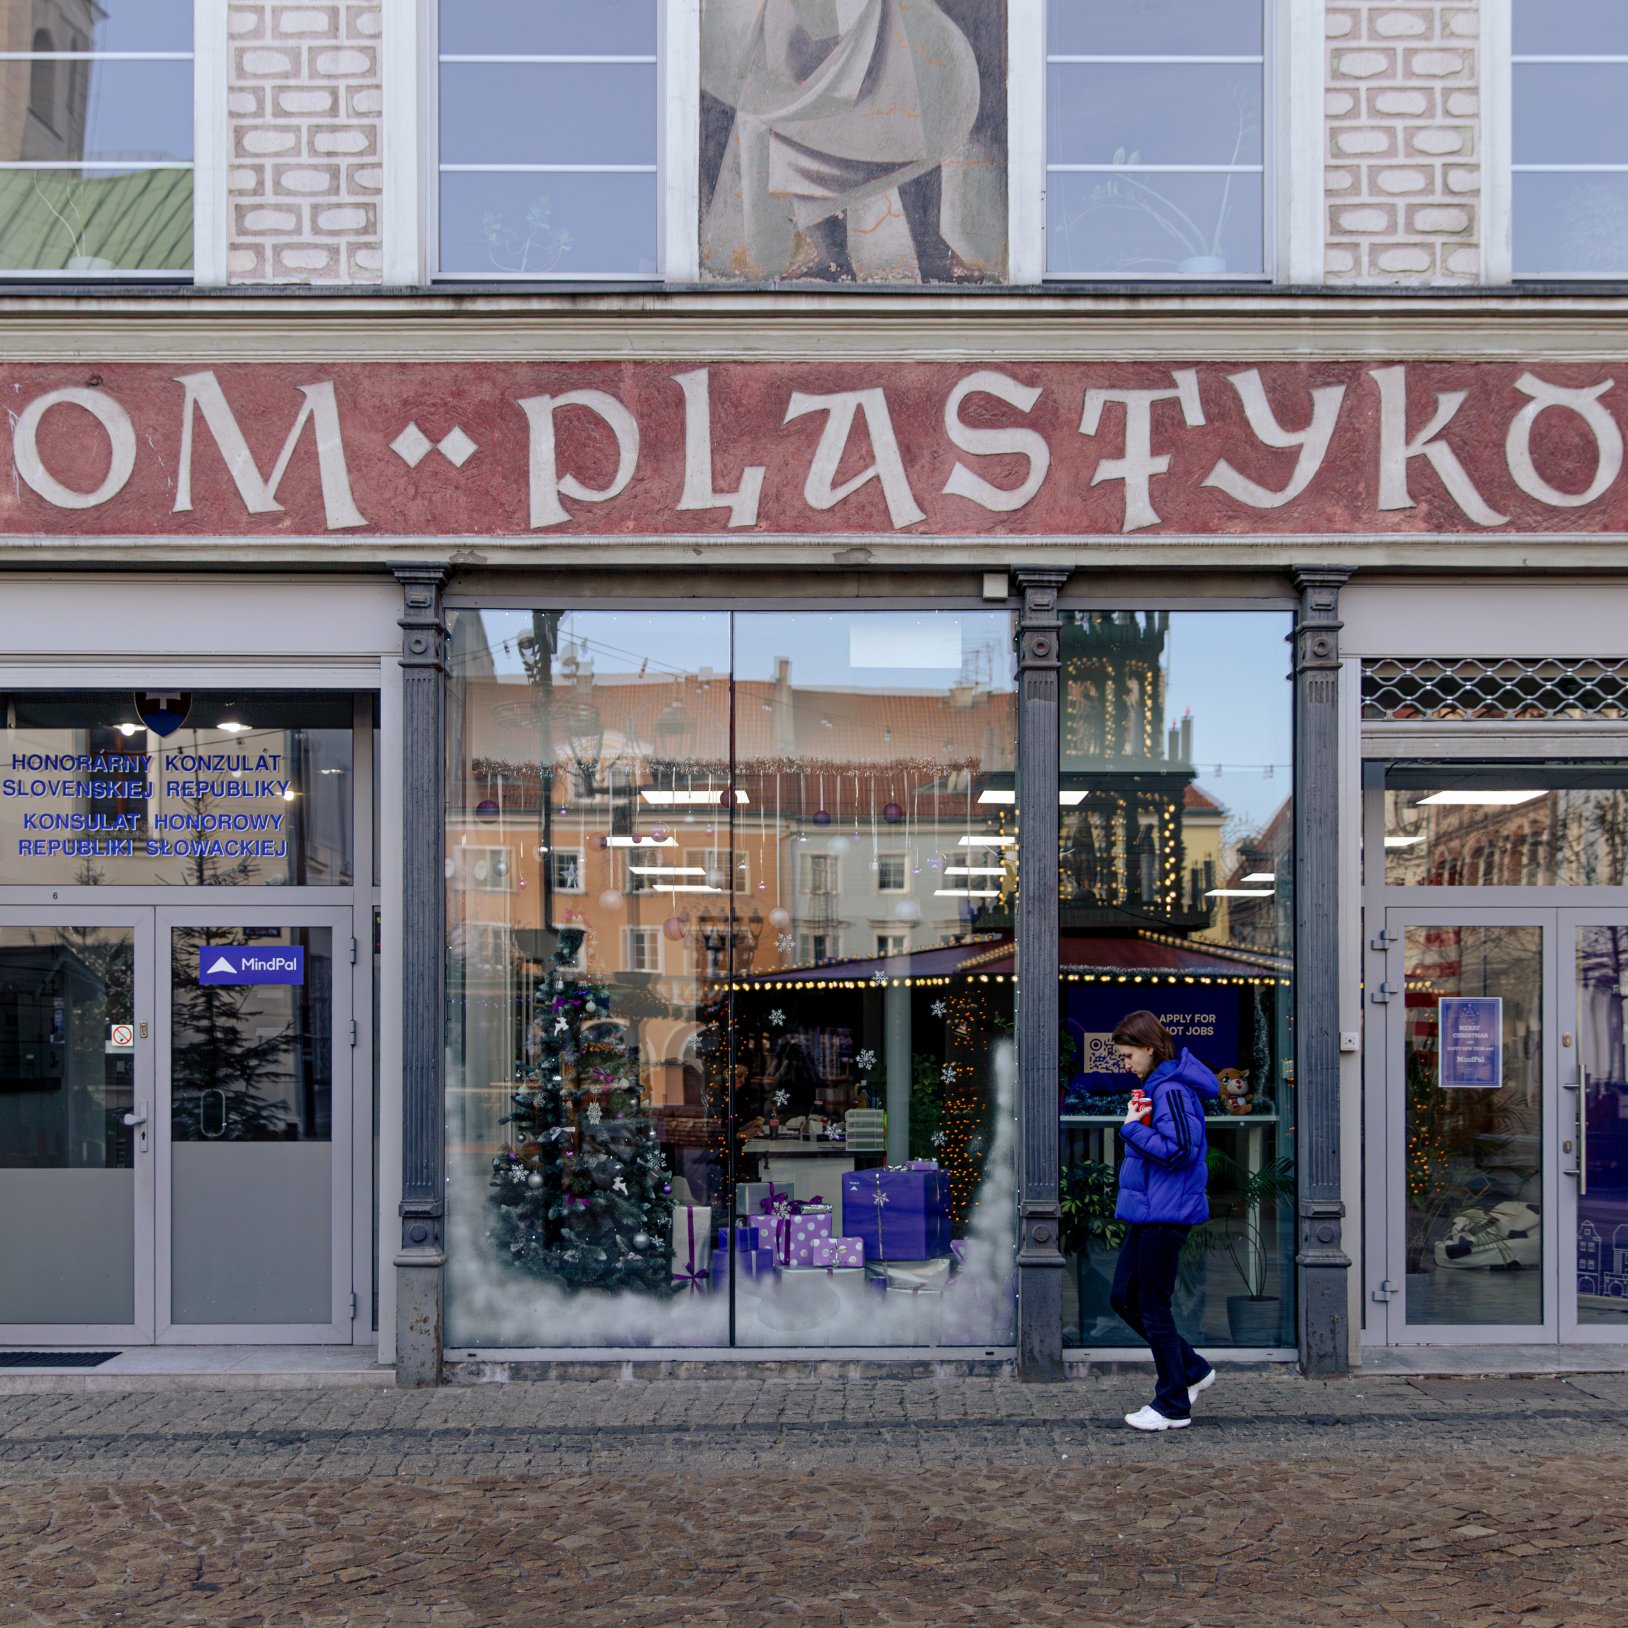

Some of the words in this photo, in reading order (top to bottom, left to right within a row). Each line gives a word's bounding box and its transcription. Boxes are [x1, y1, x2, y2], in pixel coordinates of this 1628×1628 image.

[12, 749, 152, 772] HONORÁRNY
[2, 779, 153, 799] SLOVENSKIEJ
[166, 780, 291, 799] REPUBLIKY
[23, 813, 140, 831] KONSULAT
[154, 813, 283, 831] HONOROWY
[18, 839, 133, 857] REPUBLIKI
[145, 838, 287, 858] SŁOWACKIEJ
[241, 957, 297, 971] MindPal
[1160, 1014, 1192, 1023] APPLY
[1194, 1014, 1217, 1023] FOR
[1185, 1026, 1214, 1036] JOBS
